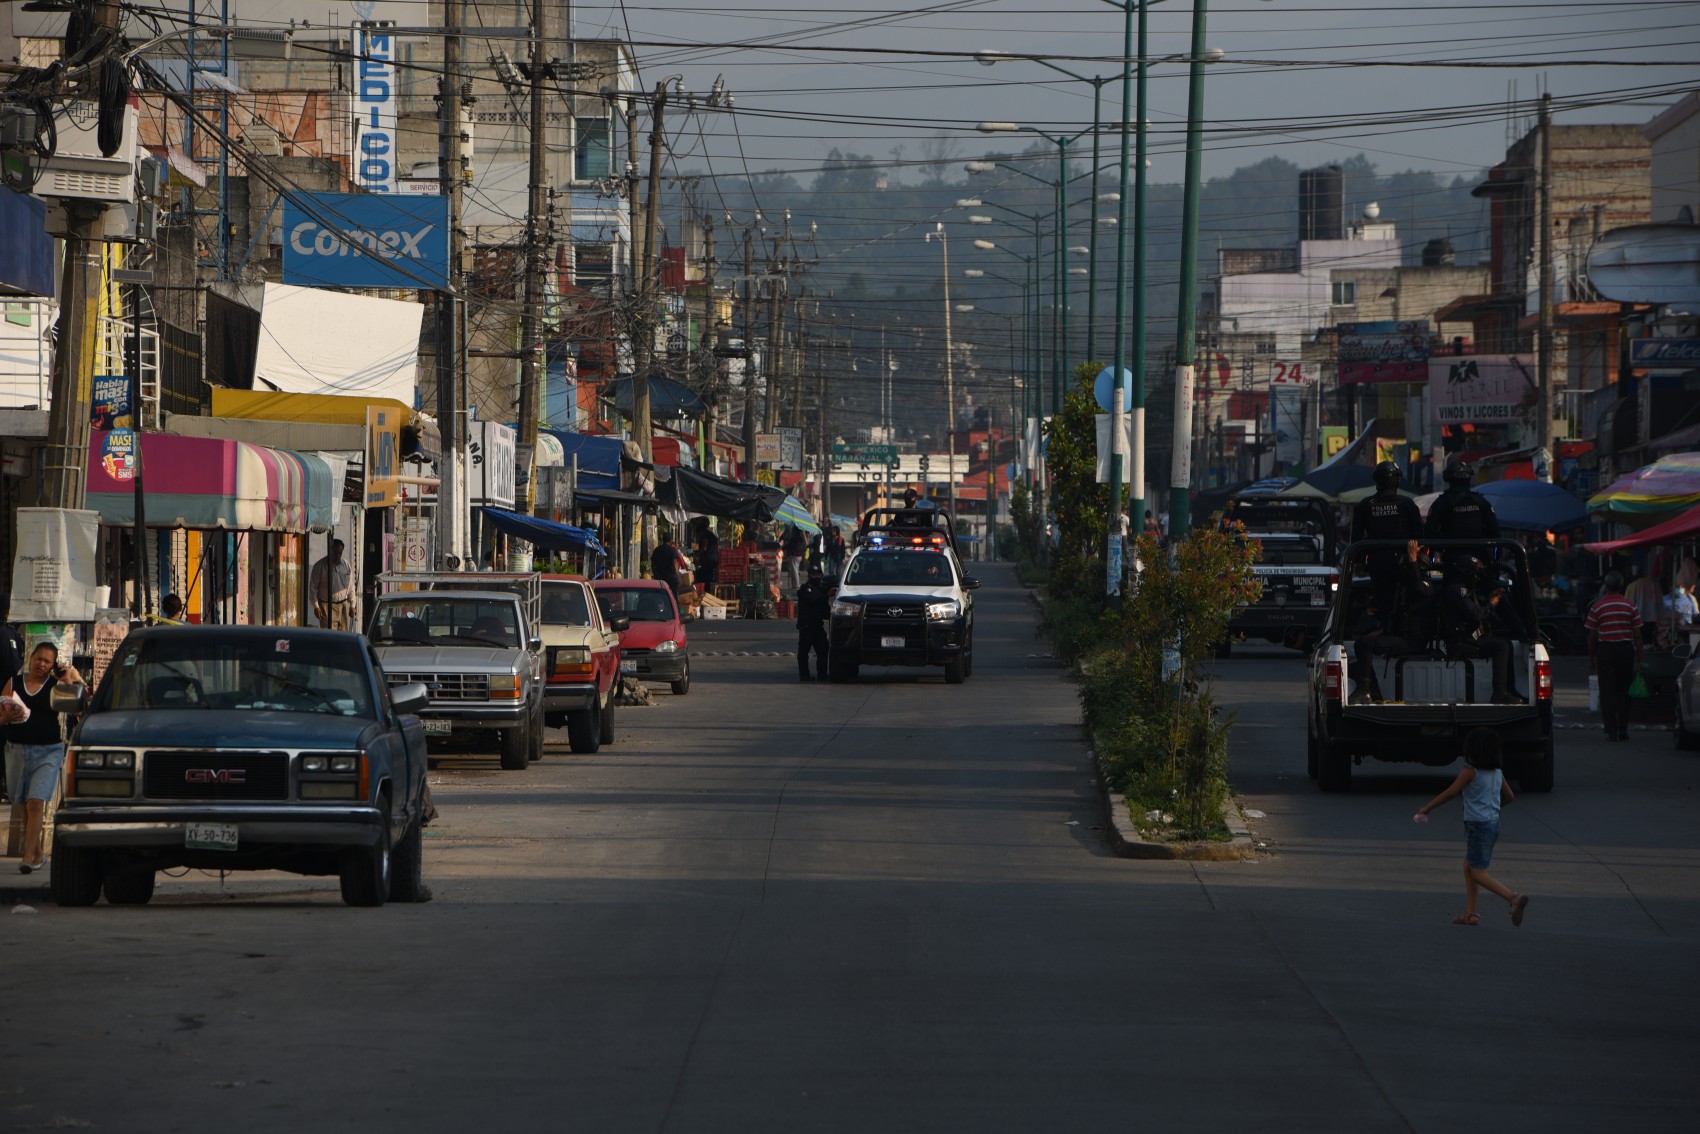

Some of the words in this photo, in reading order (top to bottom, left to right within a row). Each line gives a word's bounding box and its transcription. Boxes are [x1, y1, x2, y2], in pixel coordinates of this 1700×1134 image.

[360, 21, 390, 192] MEDICO
[290, 222, 435, 260] Comex
[1273, 362, 1302, 383] 24
[95, 378, 124, 391] Habla
[95, 402, 129, 415] migo
[1438, 405, 1465, 419] VINOS
[1466, 405, 1472, 418] Y
[1474, 404, 1508, 418] LICORES
[835, 454, 881, 462] NARANJAL
[117, 470, 133, 479] SMS
[857, 472, 925, 481] NORTE
[1292, 576, 1326, 586] MUNICIPAL
[185, 769, 247, 783] GMC
